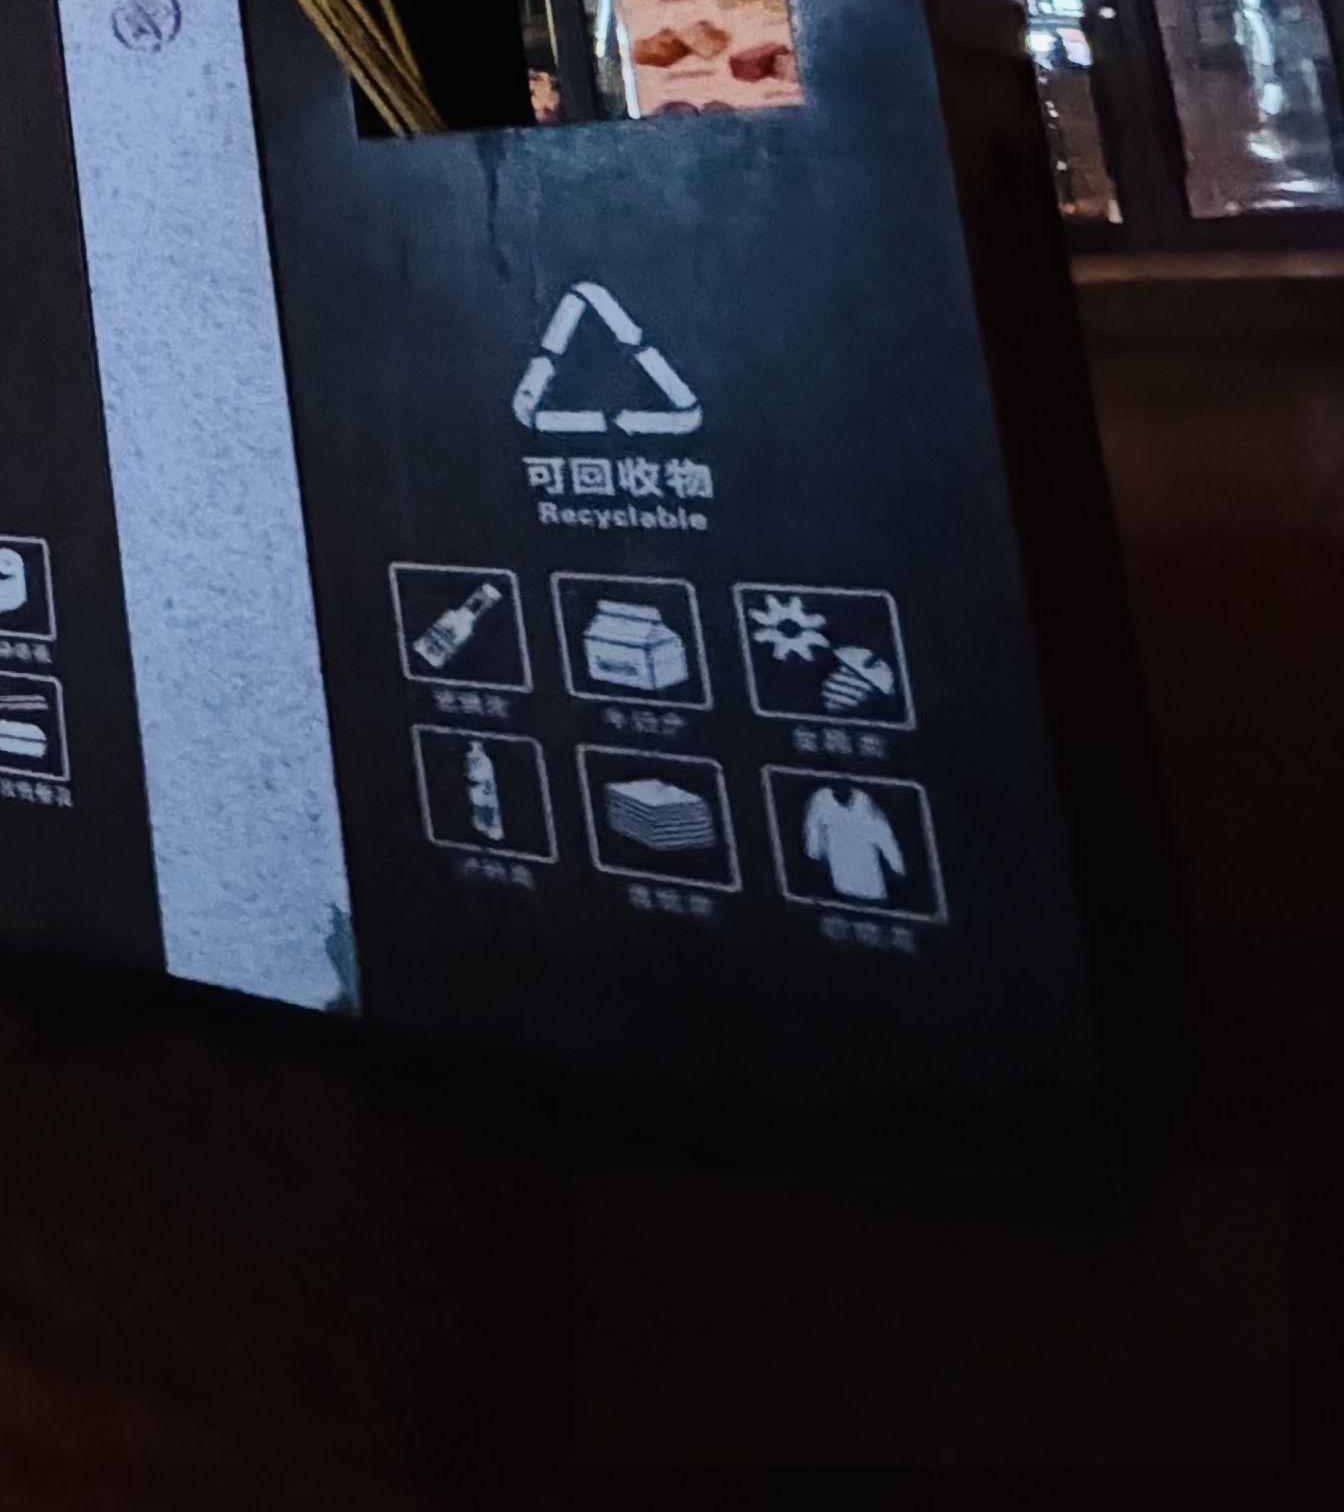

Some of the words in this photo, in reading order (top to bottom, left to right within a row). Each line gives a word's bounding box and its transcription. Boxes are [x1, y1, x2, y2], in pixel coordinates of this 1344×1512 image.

[520, 455, 714, 499] 可回收物
[537, 501, 708, 531] Recyclable
